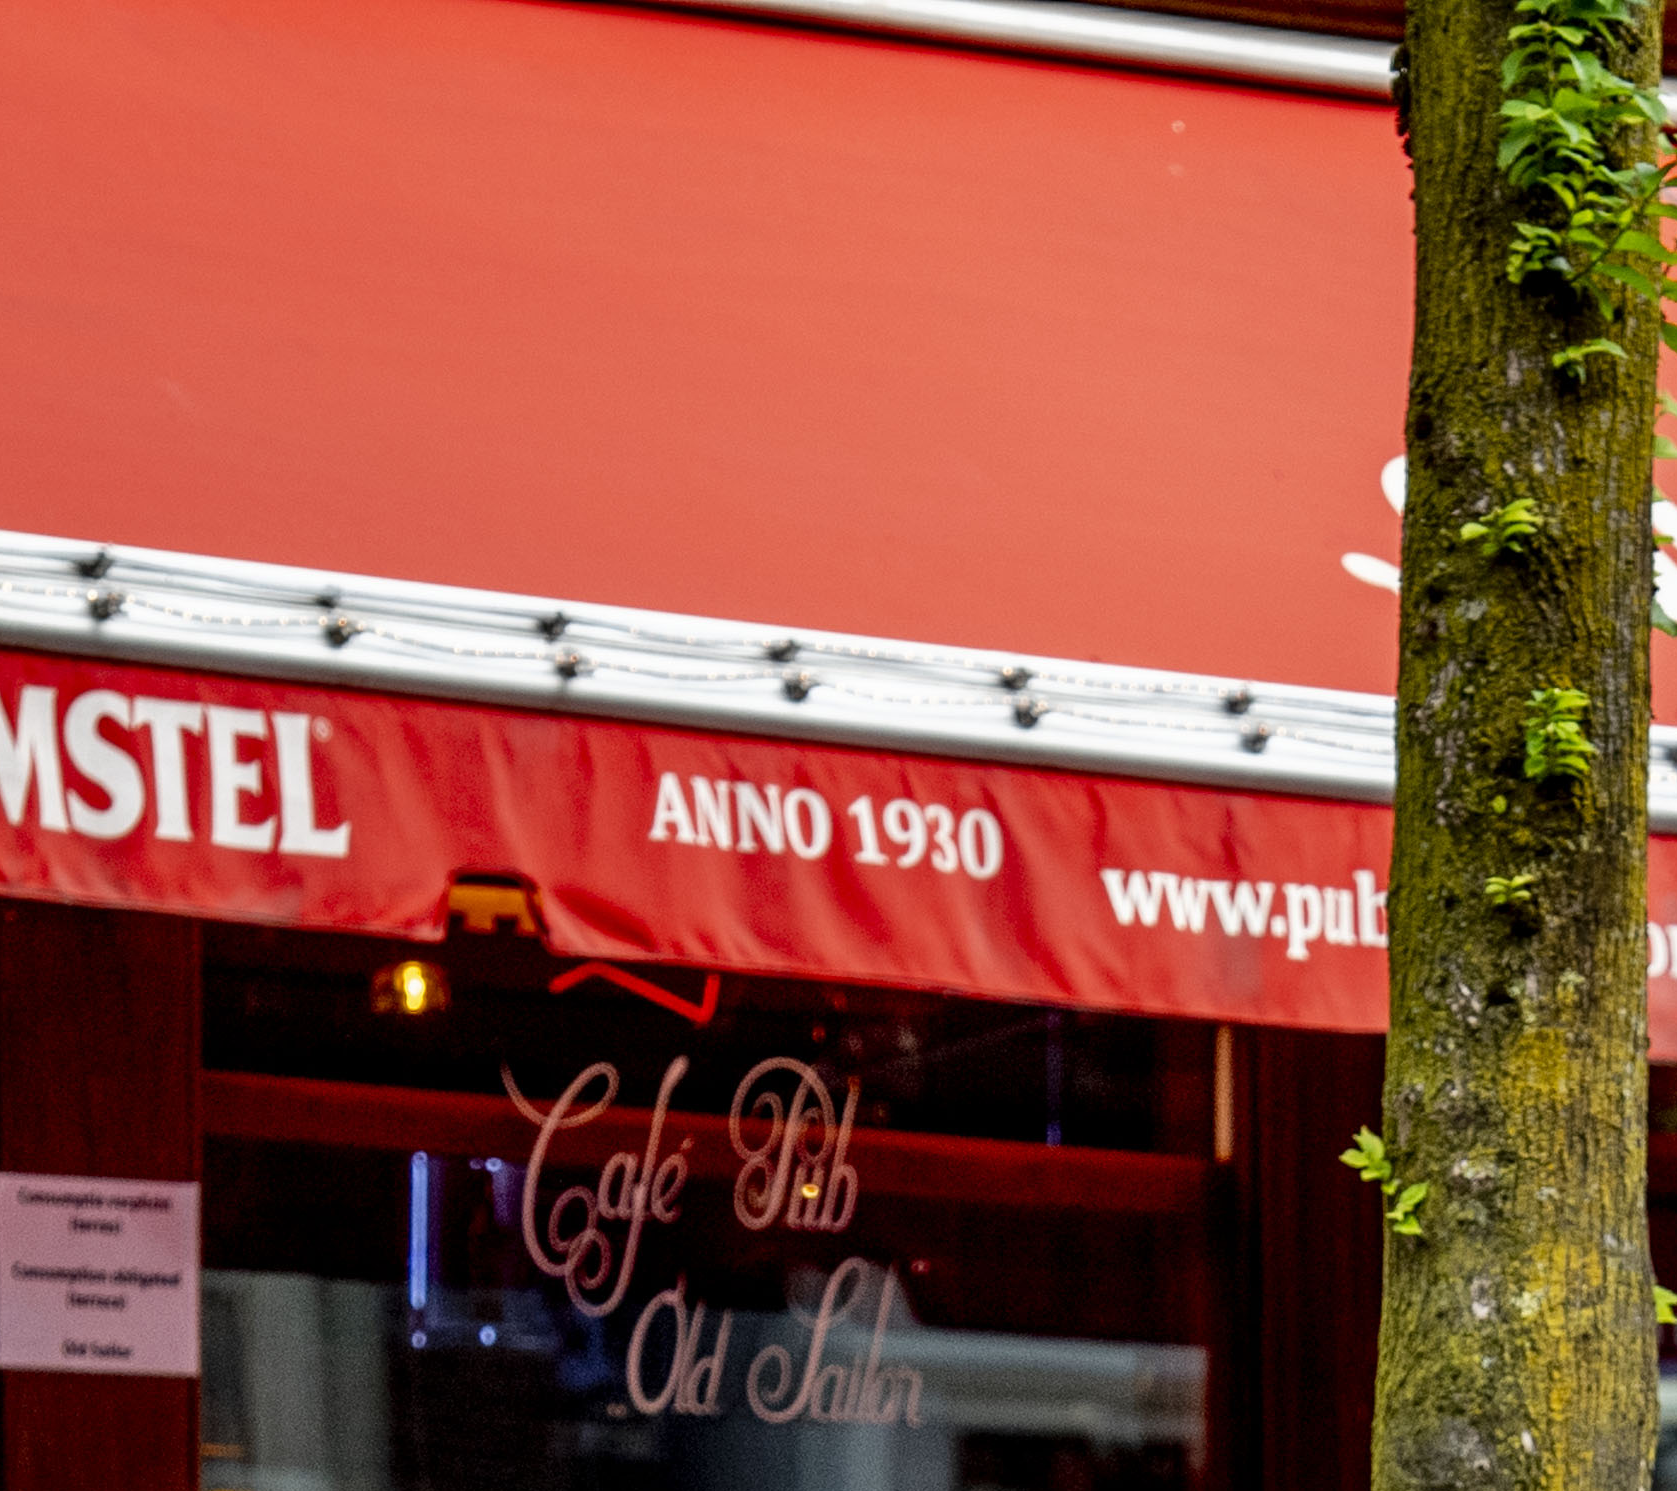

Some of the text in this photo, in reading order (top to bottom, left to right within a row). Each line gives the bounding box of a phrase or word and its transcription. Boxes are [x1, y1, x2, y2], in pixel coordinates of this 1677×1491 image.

[650, 772, 1002, 879] ANNO 1930
[499, 1055, 863, 1317] Café Pub
